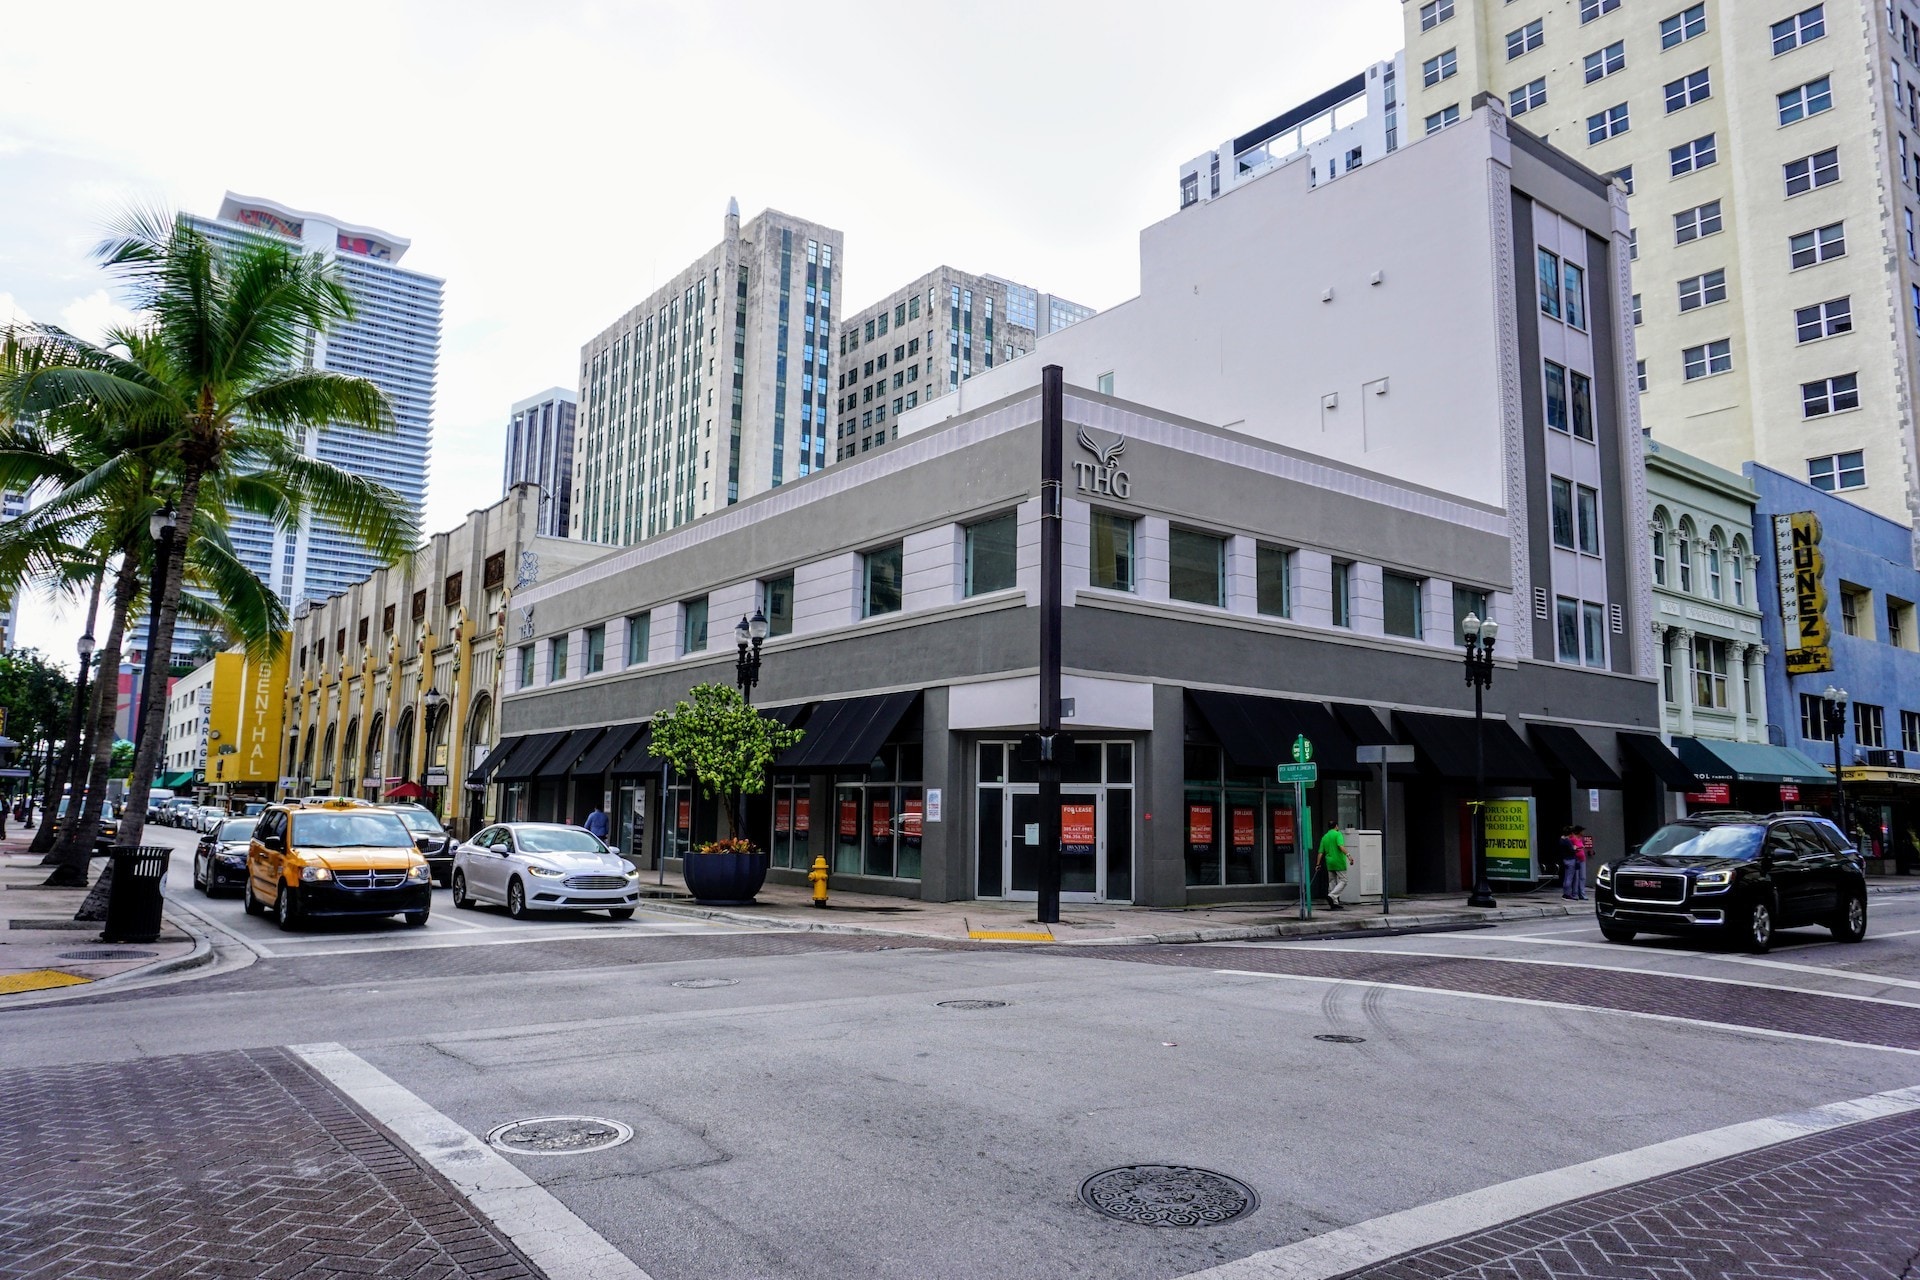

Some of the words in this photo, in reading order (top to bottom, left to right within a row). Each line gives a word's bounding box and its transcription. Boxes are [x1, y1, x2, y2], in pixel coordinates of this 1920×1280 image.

[1073, 460, 1132, 498] THG
[198, 706, 211, 768] GARAGE
[1485, 806, 1508, 814] DRUG
[1510, 806, 1522, 814] OR
[1634, 880, 1661, 888] GMC
